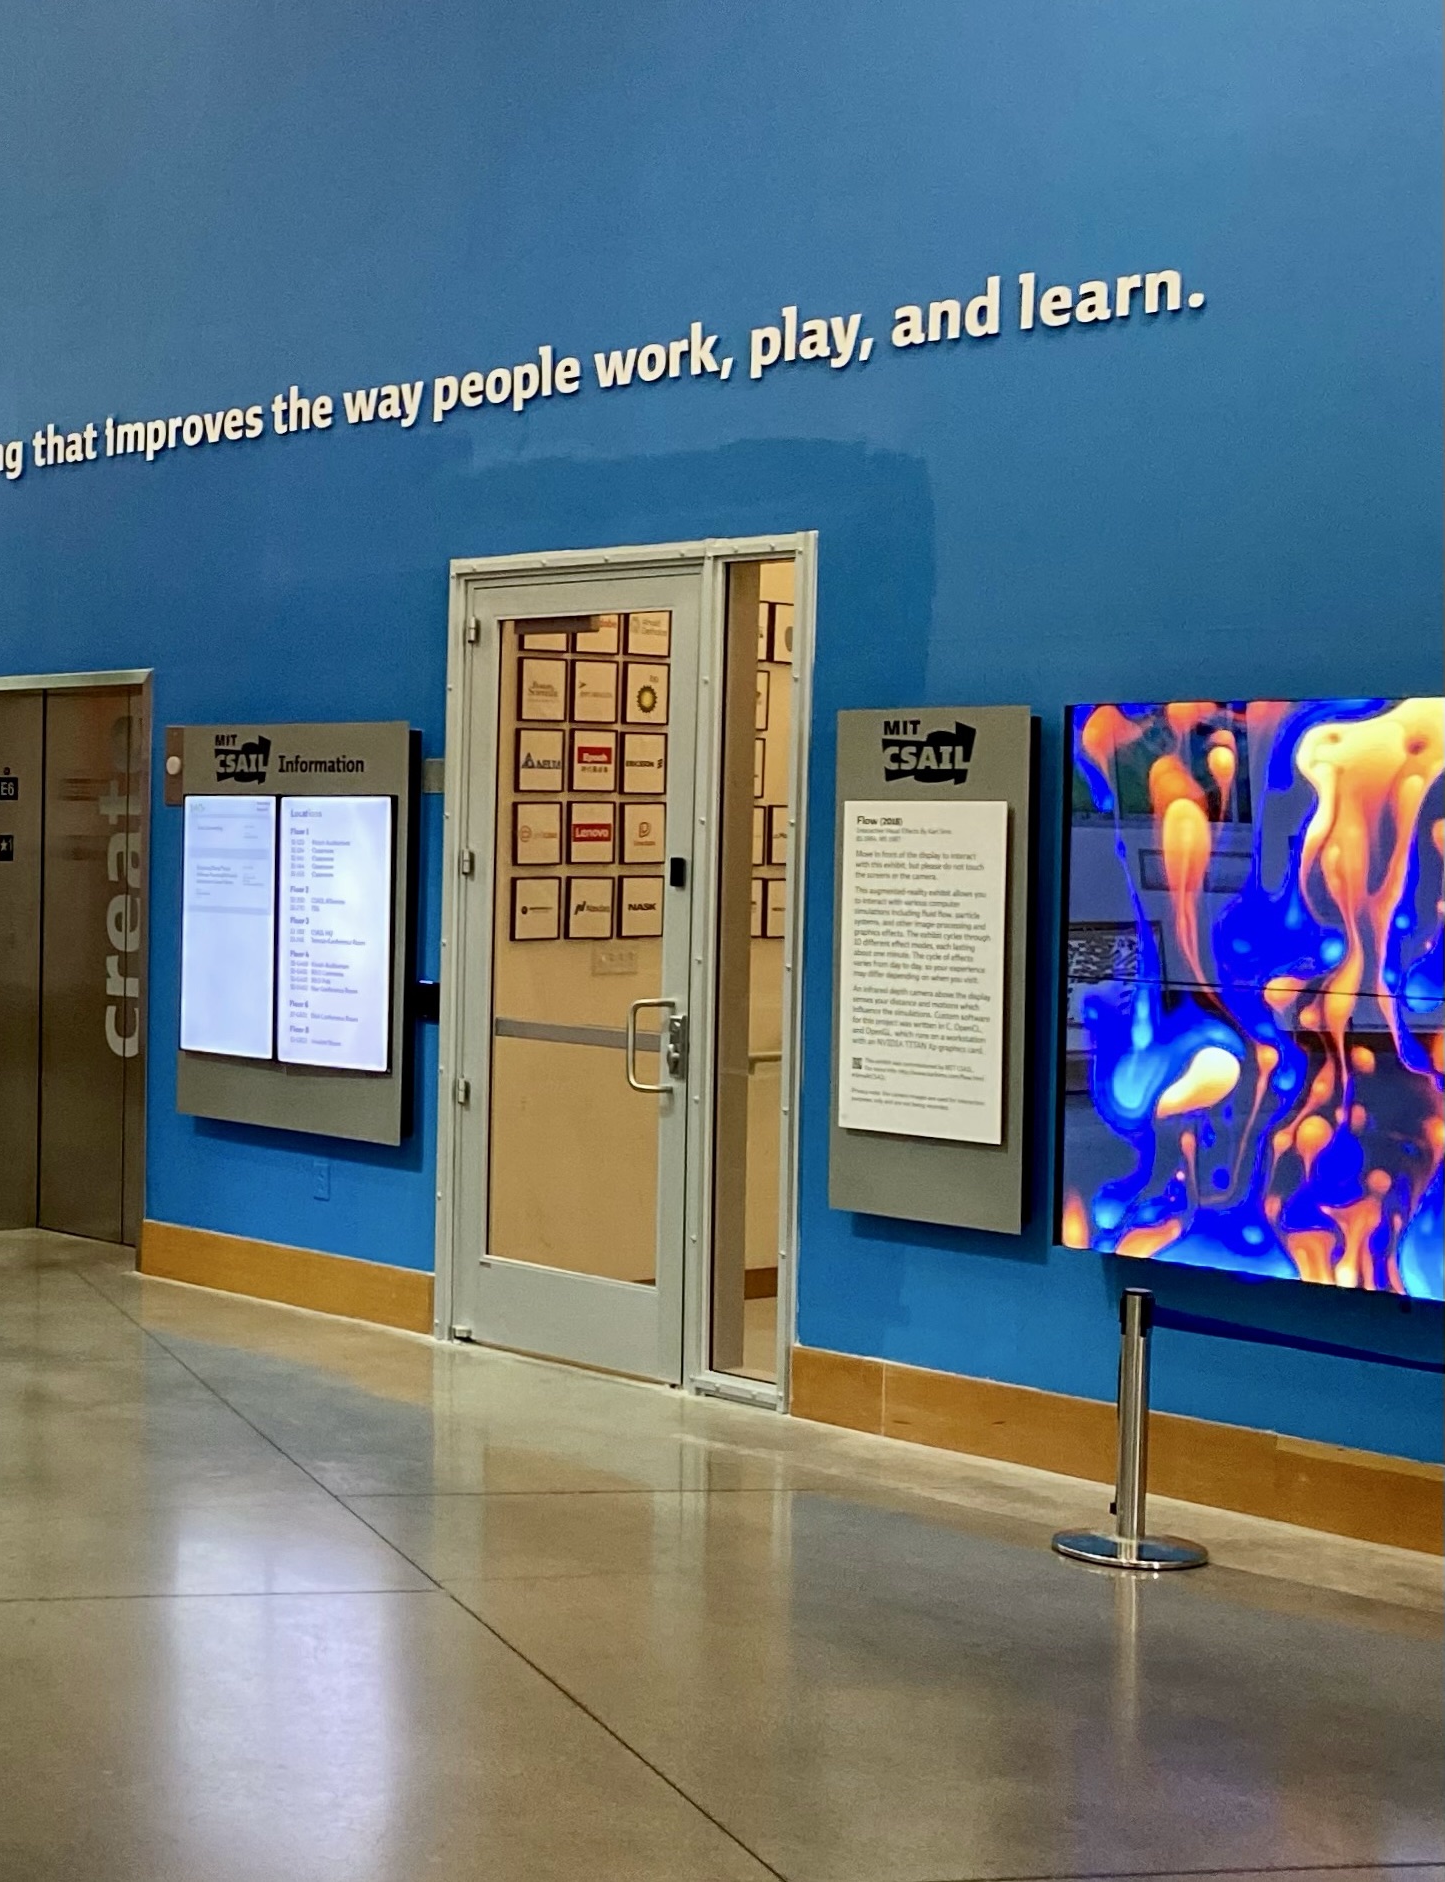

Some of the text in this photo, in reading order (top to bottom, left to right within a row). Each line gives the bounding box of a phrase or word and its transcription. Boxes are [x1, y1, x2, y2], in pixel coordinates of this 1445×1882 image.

[32, 424, 97, 467] that
[106, 402, 263, 460] improves
[272, 386, 332, 435] the
[343, 380, 424, 428] way
[433, 346, 581, 422] people
[594, 321, 734, 388] work,
[750, 305, 874, 379] play,
[891, 275, 1001, 347] and
[1019, 268, 1205, 330] learn.
[884, 720, 921, 735] MIT
[215, 734, 237, 746] MIT
[216, 753, 364, 773] CSAIL Information
[883, 746, 970, 770] CSAIL
[0, 782, 14, 796] E6
[575, 827, 609, 838] Lenovo
[100, 714, 142, 1058] create
[628, 903, 656, 911] NASK
